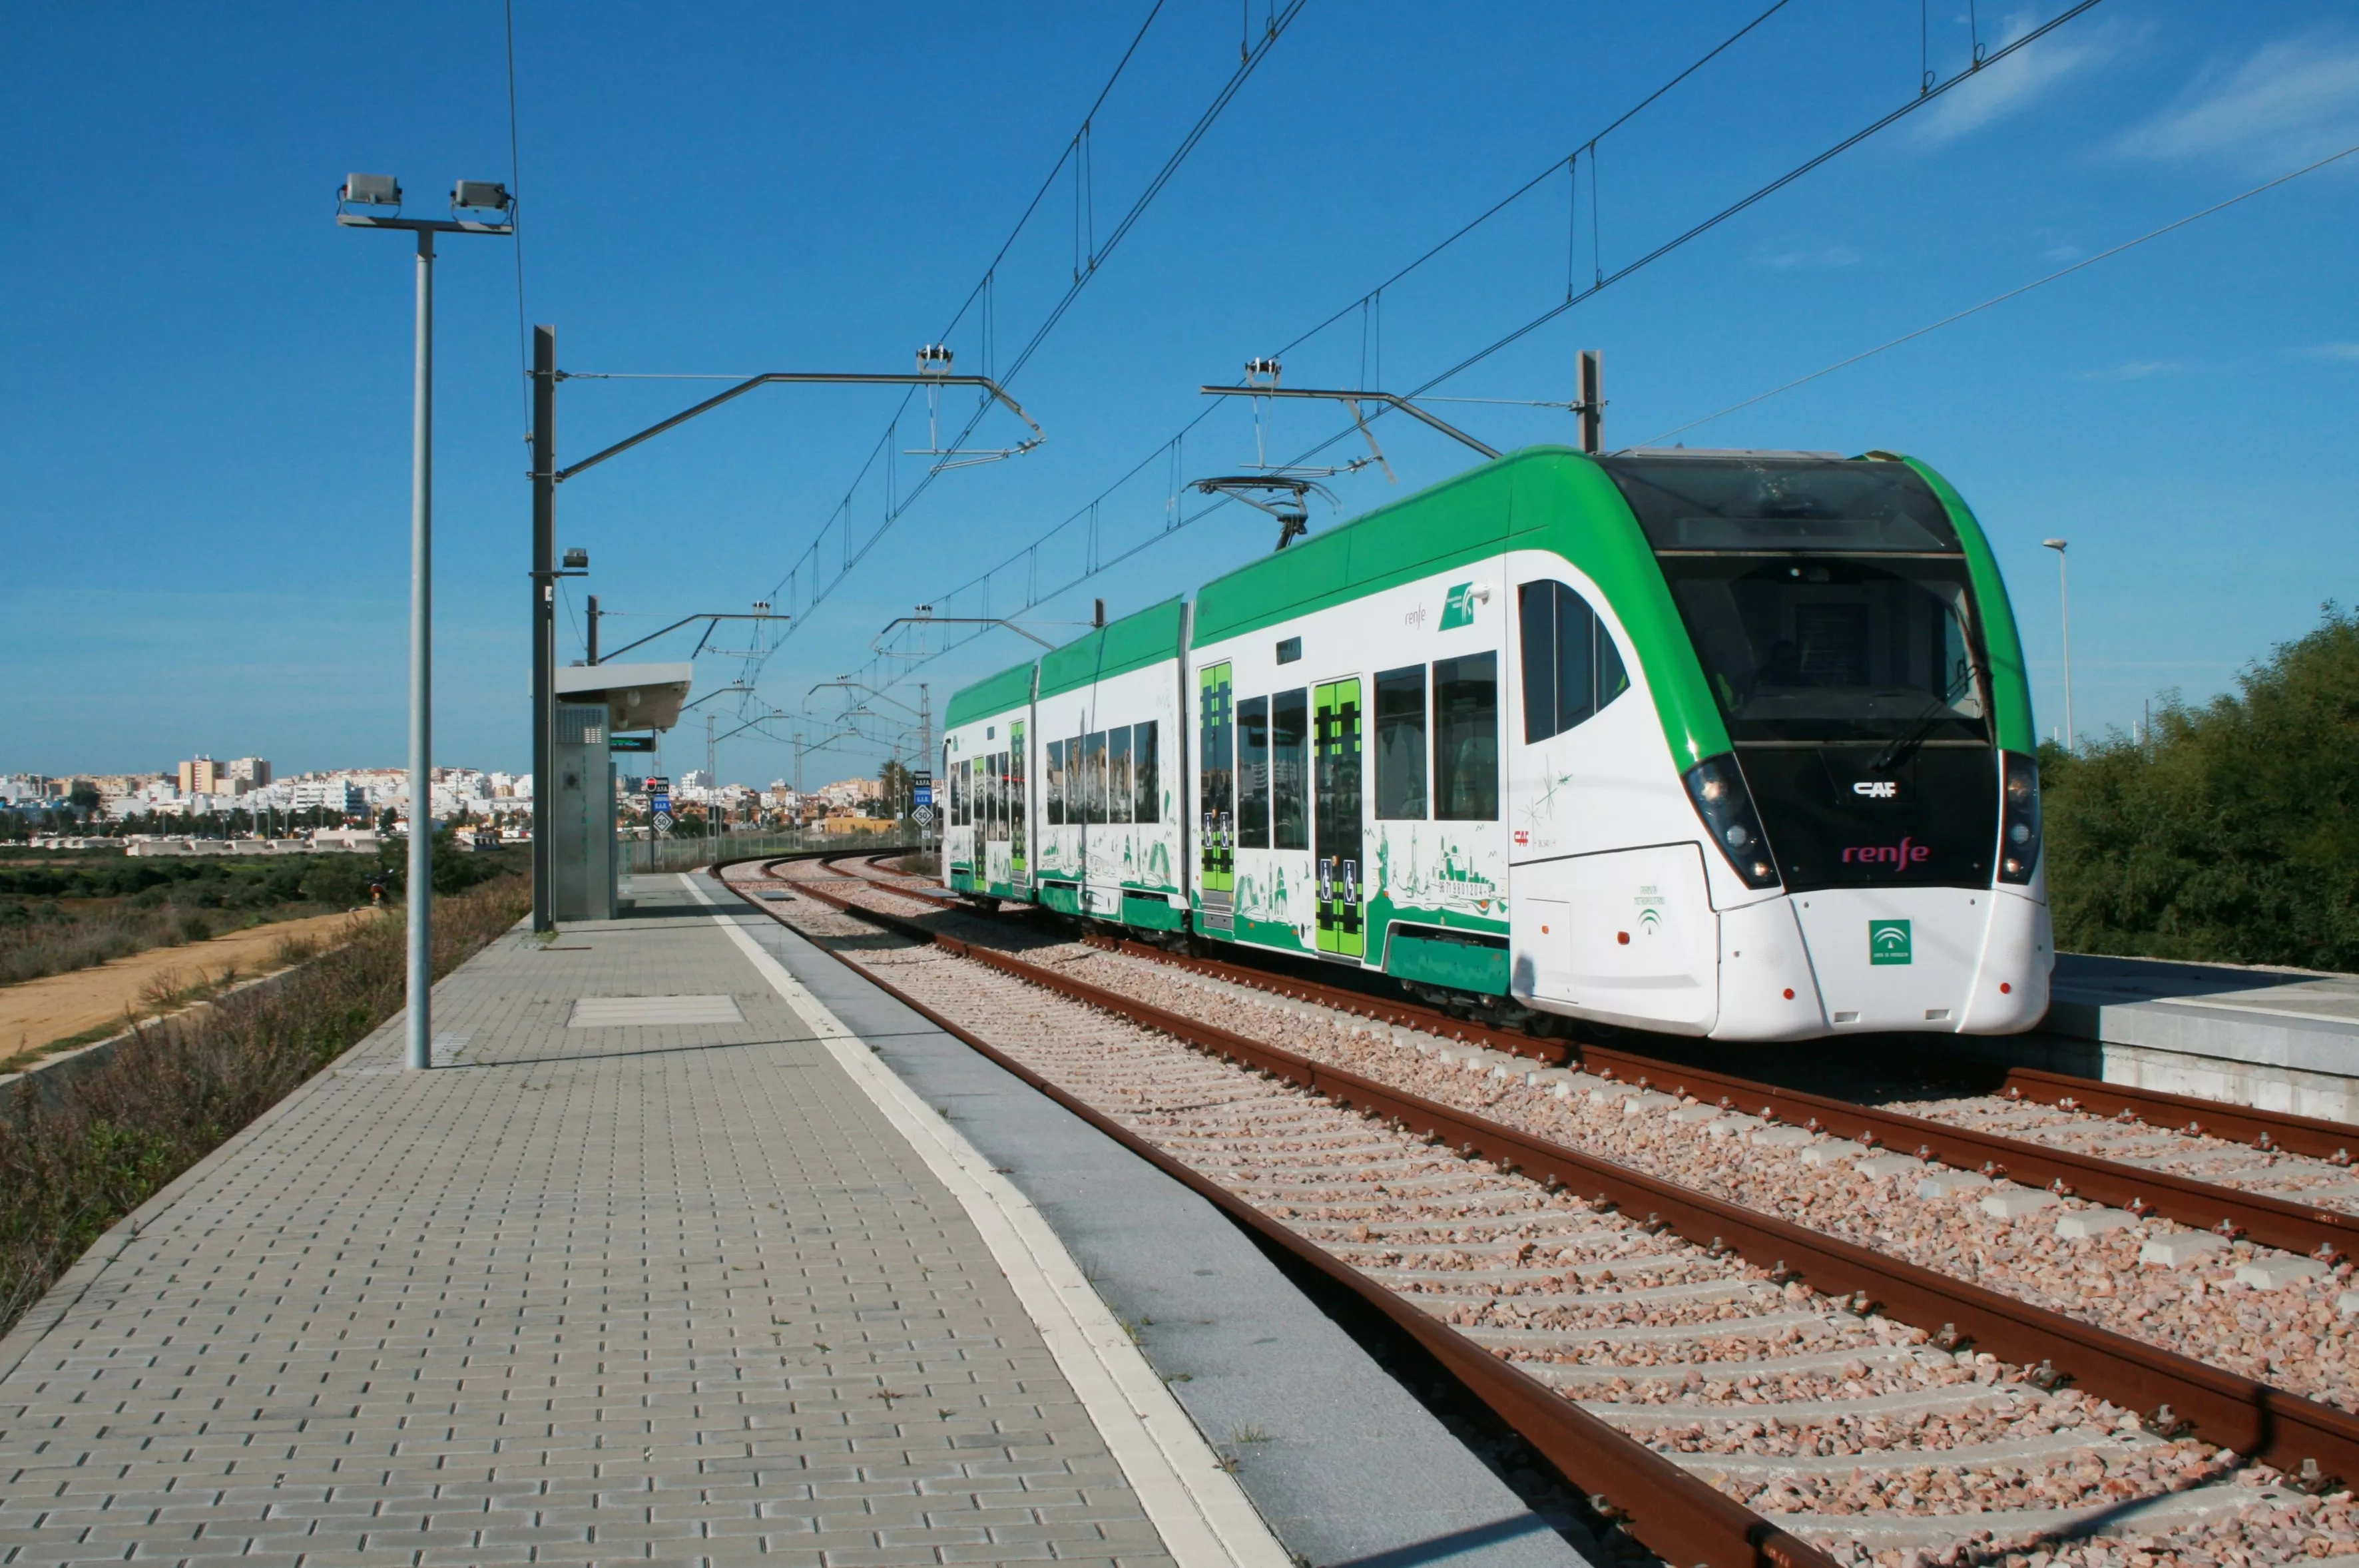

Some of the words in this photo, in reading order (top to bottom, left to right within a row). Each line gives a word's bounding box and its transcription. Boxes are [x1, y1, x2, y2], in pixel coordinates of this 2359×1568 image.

[1405, 602, 1426, 630] renfe
[1853, 782, 1897, 798] CAF
[1514, 830, 1529, 847] CAF
[1842, 836, 1930, 872] renfe
